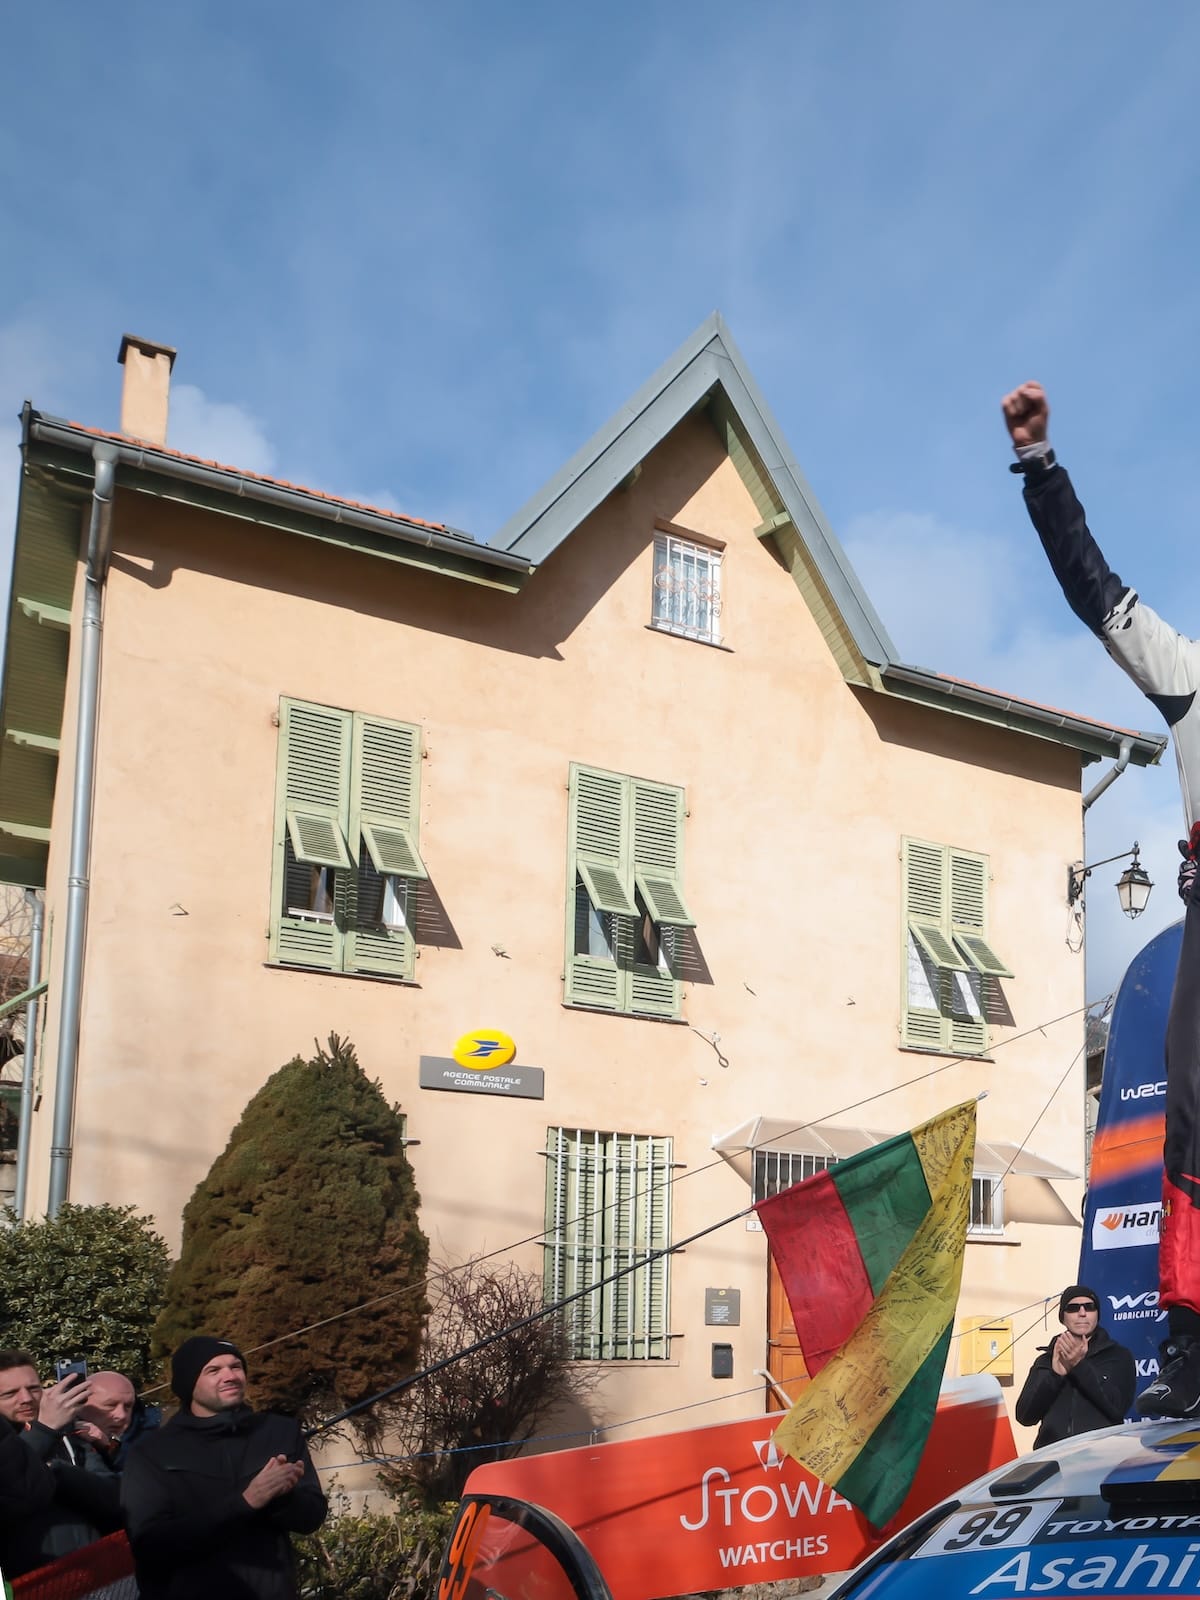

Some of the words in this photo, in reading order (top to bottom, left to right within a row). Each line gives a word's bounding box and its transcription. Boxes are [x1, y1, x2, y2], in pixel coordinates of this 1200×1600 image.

[443, 1070, 482, 1081] AGENCE
[483, 1074, 522, 1085] POSTALE
[454, 1079, 511, 1090] COMMUNALE
[1120, 1081, 1168, 1101] WRC
[1114, 1309, 1159, 1321] LUBRICANTS
[679, 1466, 853, 1531] STOWA
[943, 1506, 1033, 1551] 99
[718, 1535, 829, 1568] WATCHES
